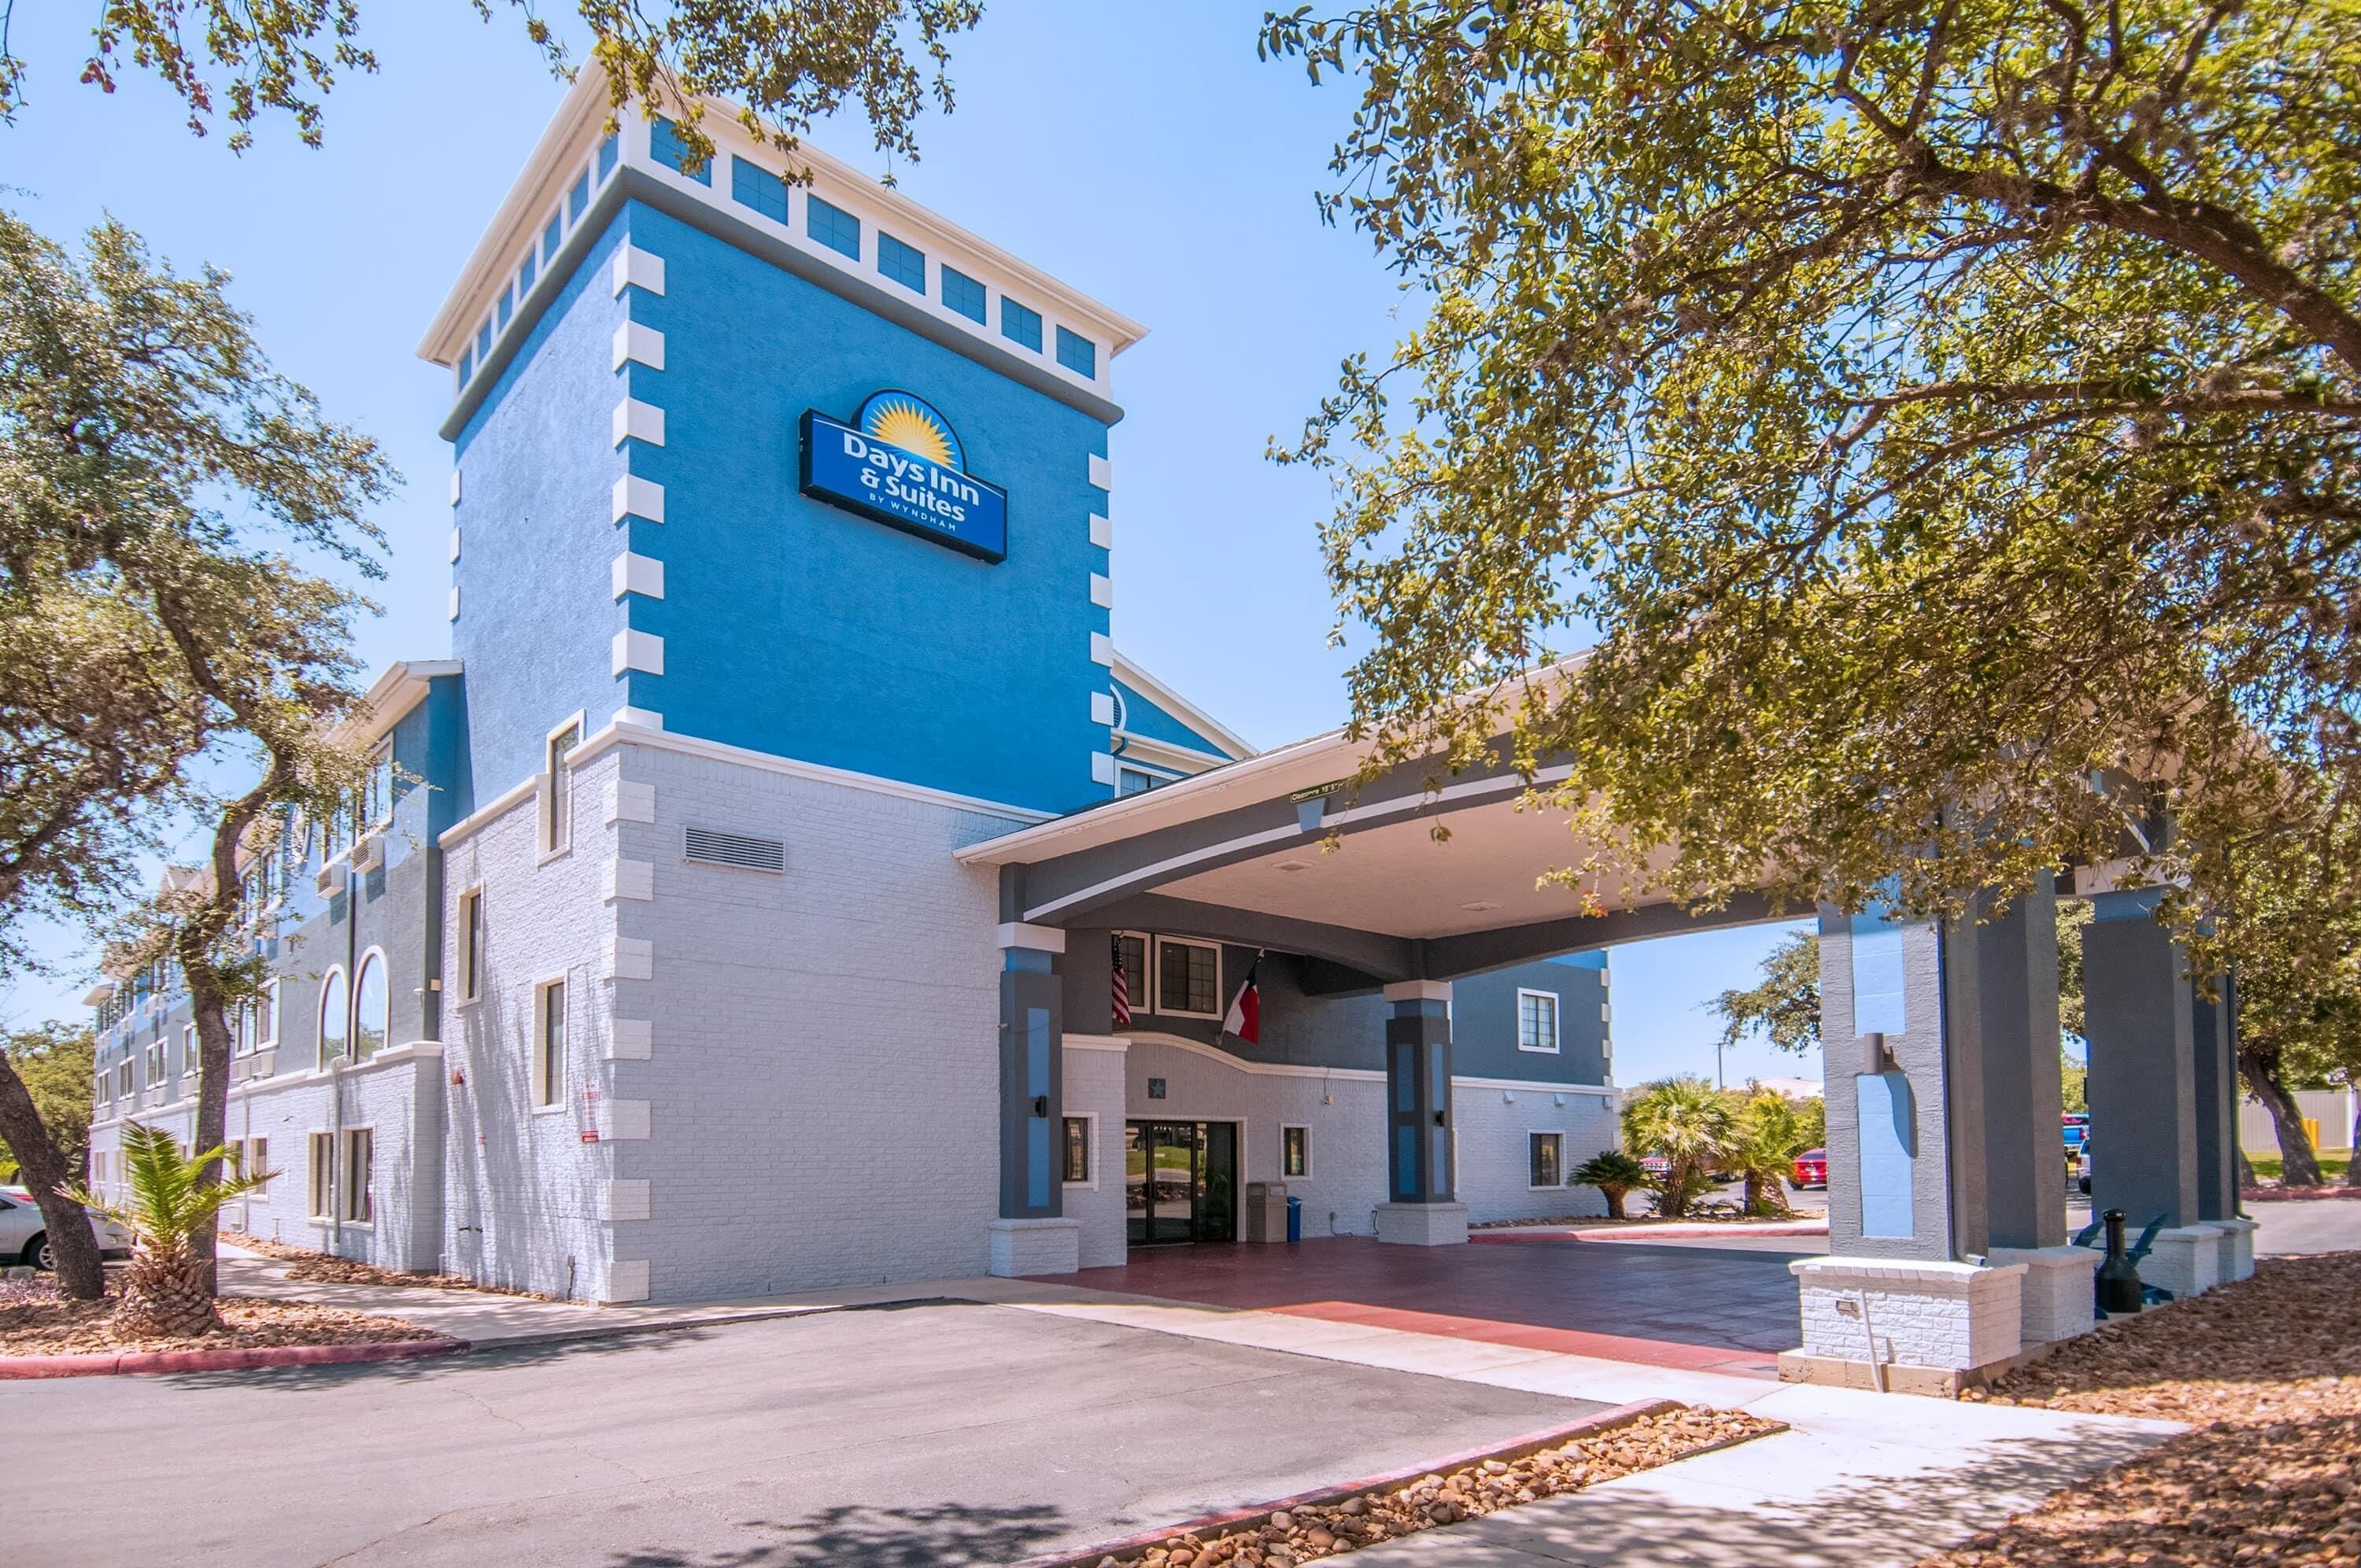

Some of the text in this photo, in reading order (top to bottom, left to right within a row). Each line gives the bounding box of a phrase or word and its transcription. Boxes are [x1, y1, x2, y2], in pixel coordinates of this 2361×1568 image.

[844, 433, 980, 506] Days Inn
[860, 468, 965, 522] & Suites
[869, 493, 956, 531] BY WYNDHAM
